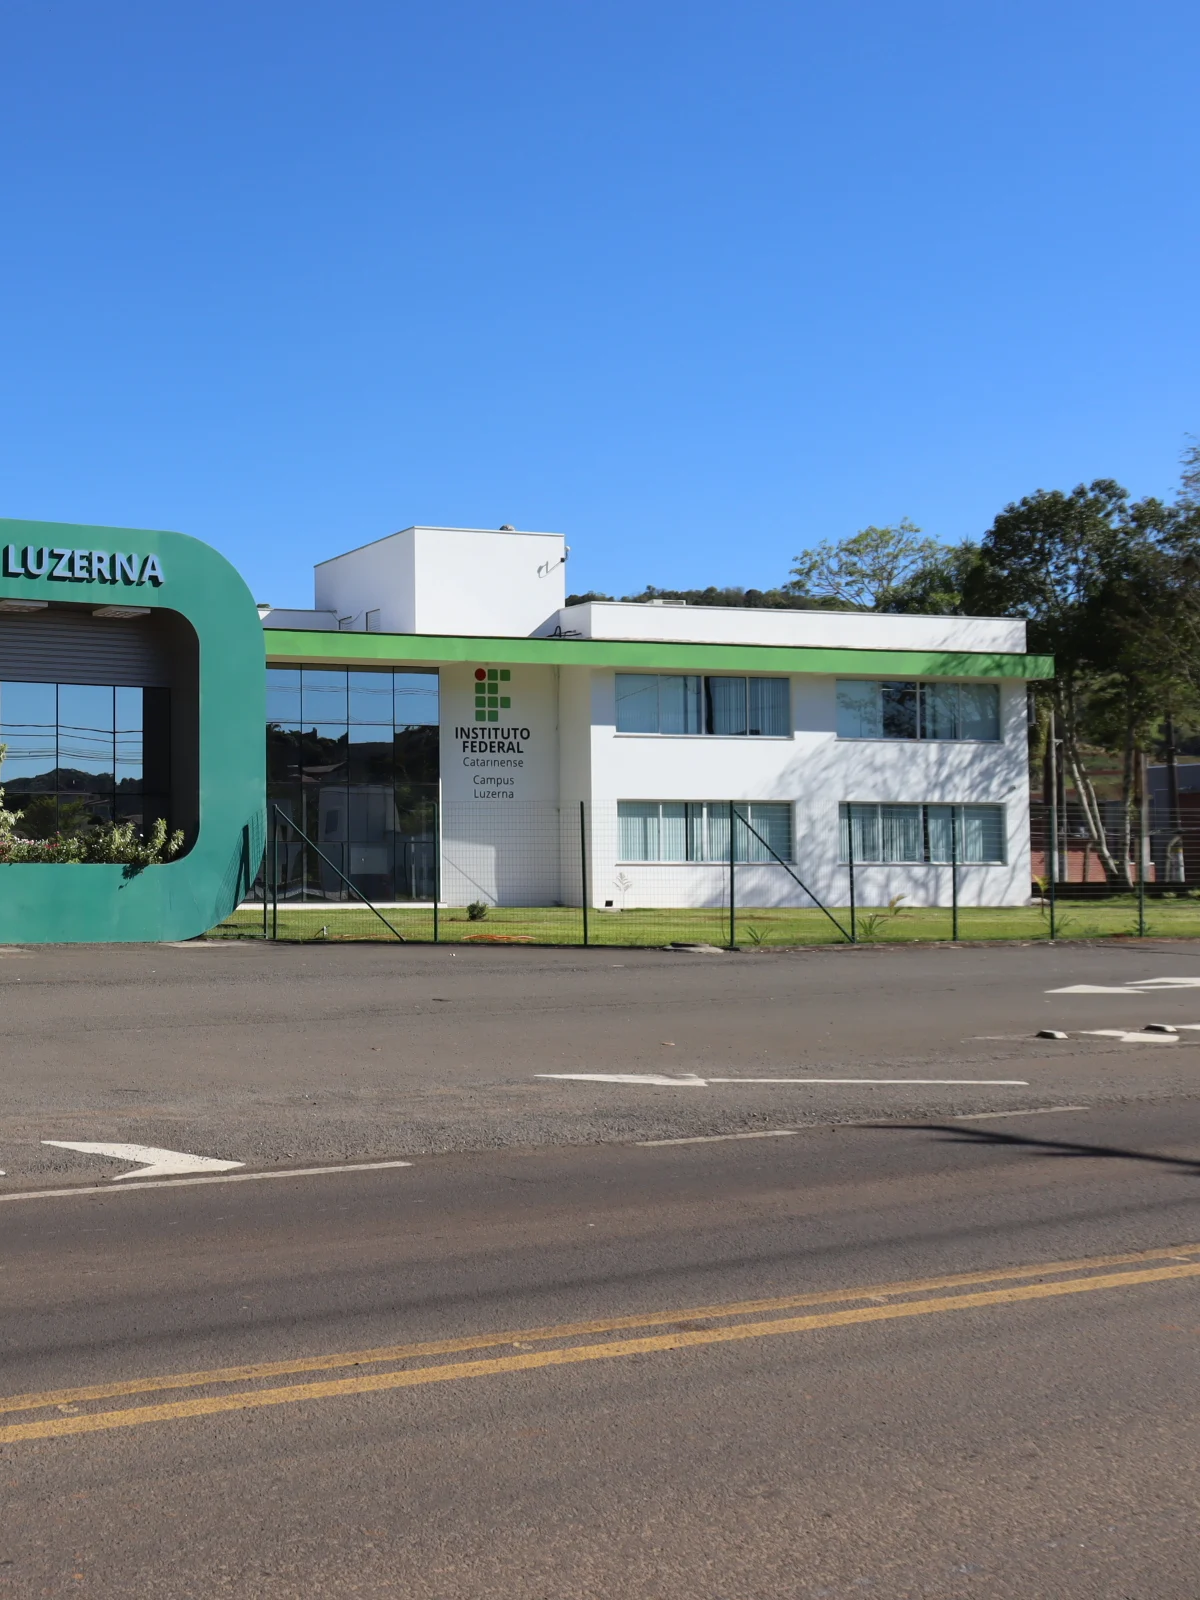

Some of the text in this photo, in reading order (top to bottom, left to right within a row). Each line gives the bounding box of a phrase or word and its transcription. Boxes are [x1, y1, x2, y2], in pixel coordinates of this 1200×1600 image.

[3, 544, 164, 587] LUZERNA
[455, 727, 531, 740] INSTITUTO
[462, 741, 524, 753] FEDERAL
[463, 757, 524, 767] Catarinense
[473, 775, 514, 787] Campus
[473, 789, 514, 798] Luzerna
